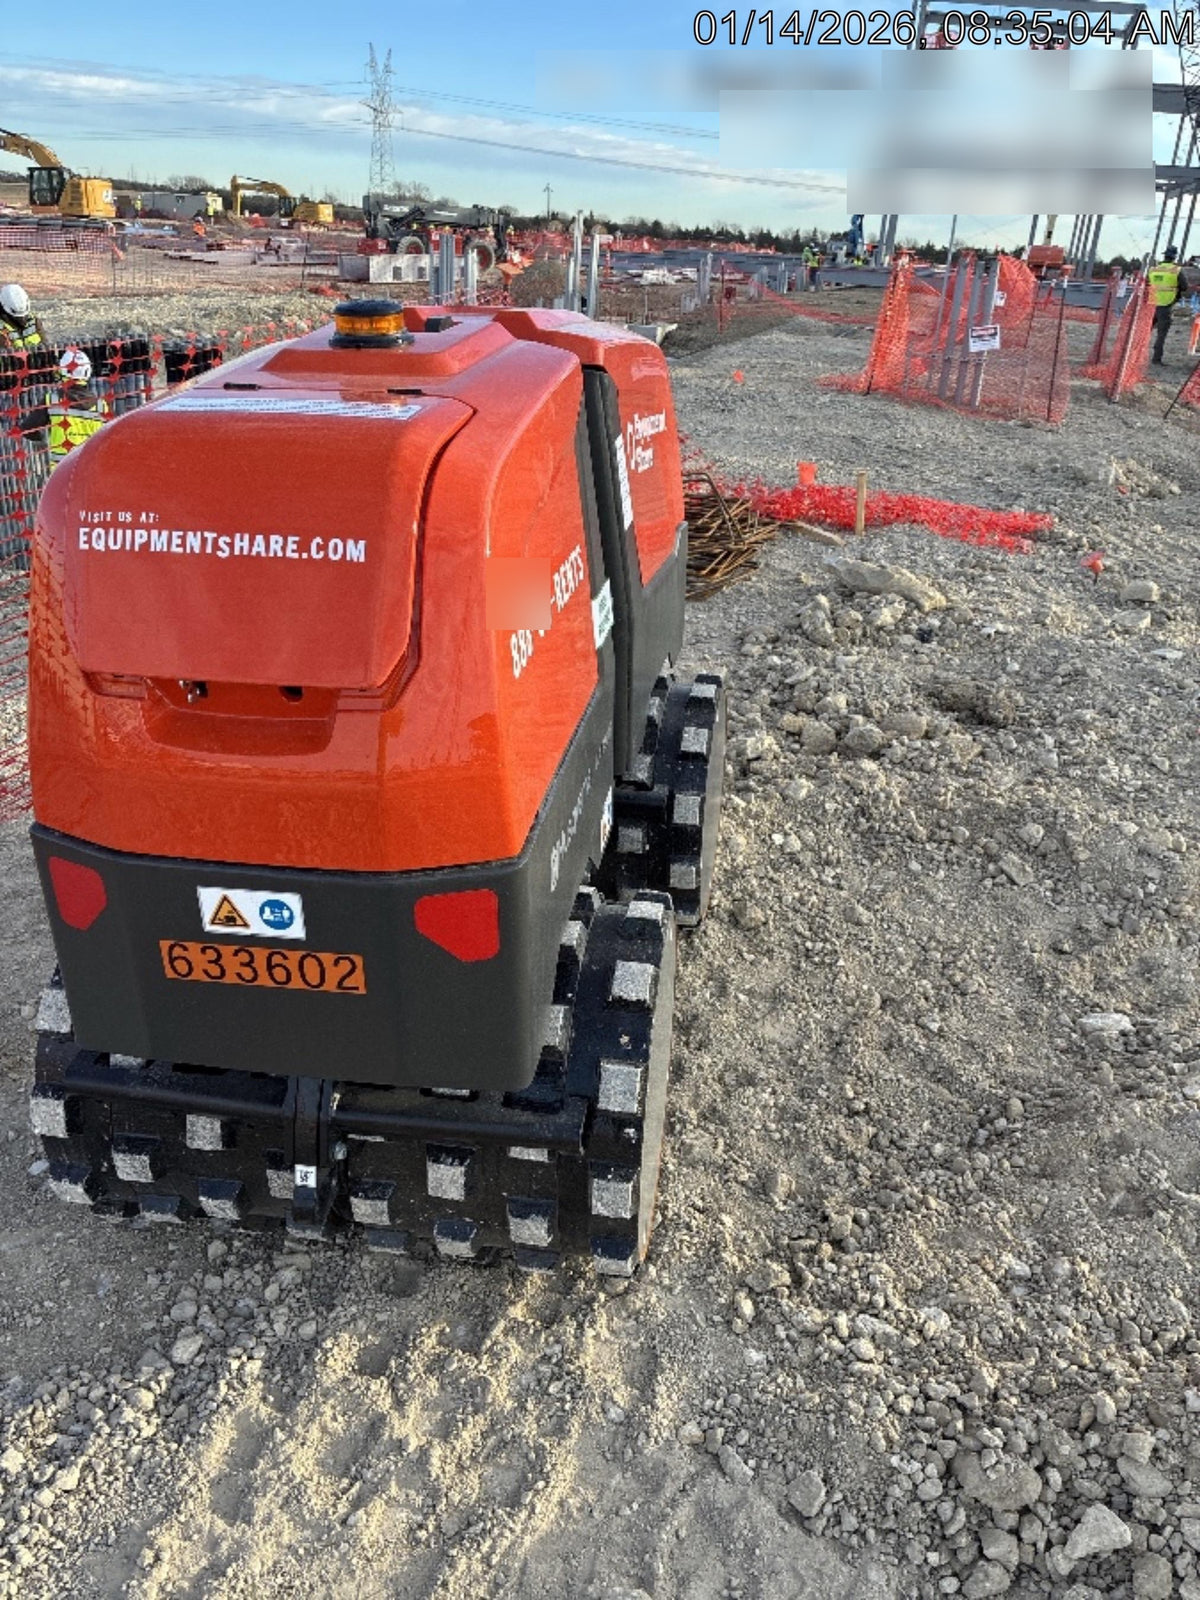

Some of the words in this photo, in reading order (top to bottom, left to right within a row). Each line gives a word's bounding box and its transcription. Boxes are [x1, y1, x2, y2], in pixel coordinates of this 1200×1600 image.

[79, 510, 112, 523] VISIT
[118, 511, 132, 523] US
[140, 512, 159, 523] AT:
[78, 527, 367, 562] EQUIPMENTSHARE.COM
[167, 942, 360, 990] 633602
